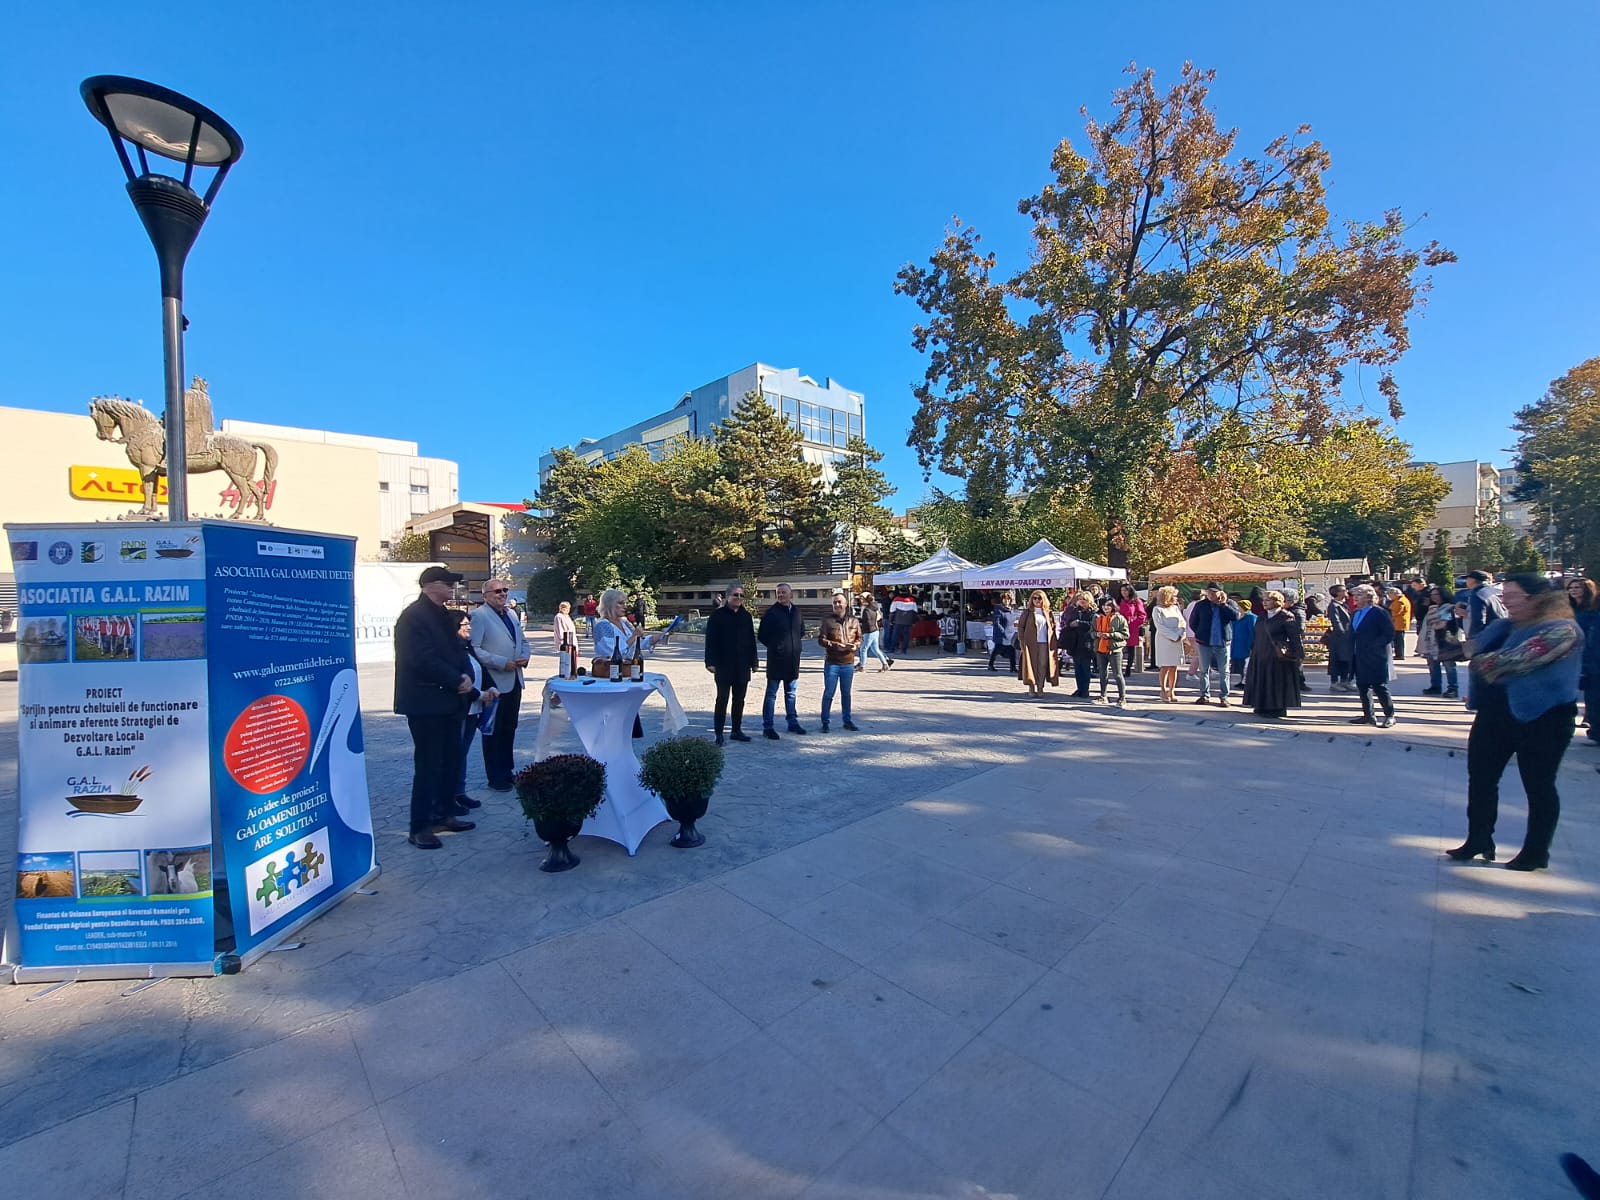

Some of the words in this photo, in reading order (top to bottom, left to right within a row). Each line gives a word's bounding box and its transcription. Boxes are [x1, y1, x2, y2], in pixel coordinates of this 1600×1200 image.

[219, 479, 277, 510] HM
[121, 540, 146, 549] PNDR
[214, 566, 271, 578] ASOCIATIA
[271, 567, 291, 579] GAL
[291, 568, 328, 580] OAMENII
[20, 587, 95, 605] ASOCIATIA
[101, 586, 140, 603] G.A.L.
[145, 585, 190, 602] RAZIM
[232, 655, 345, 680] www.galoameniideltei.ro
[86, 688, 123, 699] PROIECT
[48, 703, 80, 716] pentru
[83, 701, 126, 714] cheltuieli
[128, 701, 139, 712] de
[141, 700, 198, 712] functionare
[30, 718, 37, 729] si
[39, 718, 77, 729] animare
[80, 716, 118, 728] aferente
[121, 715, 164, 729] Strategiei
[167, 715, 179, 726] de
[64, 731, 113, 743] Dezvoltare
[116, 730, 144, 742] Locala
[76, 746, 102, 757] G.A.L.
[105, 745, 135, 756] Razim"
[67, 776, 102, 786] G.A.L.
[73, 785, 112, 794] RAZIM
[246, 807, 257, 821] Ai
[257, 807, 264, 816] o
[263, 799, 280, 813] idee
[280, 793, 291, 806] de
[291, 786, 315, 803] proiect
[315, 780, 319, 791] ?
[236, 822, 260, 841] GAL
[258, 808, 299, 832] OAMENII
[299, 792, 328, 813] DELTEI
[253, 833, 274, 852] ARE
[275, 815, 315, 840] SOLUTIA
